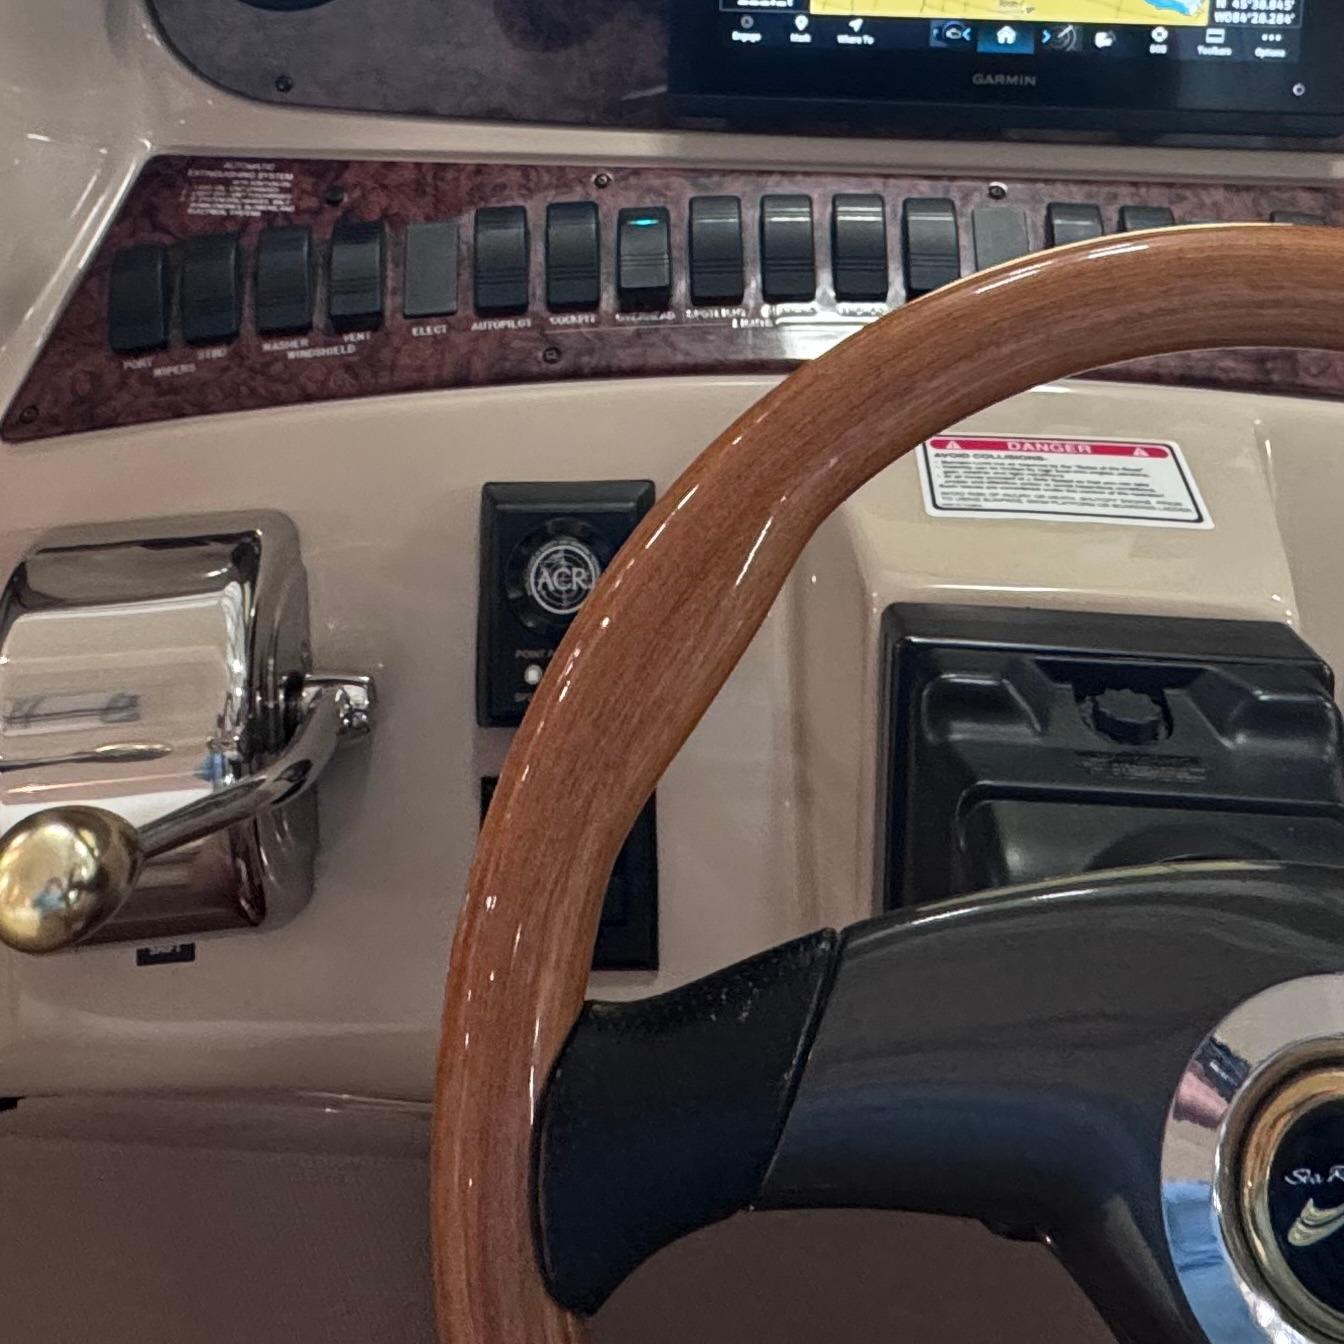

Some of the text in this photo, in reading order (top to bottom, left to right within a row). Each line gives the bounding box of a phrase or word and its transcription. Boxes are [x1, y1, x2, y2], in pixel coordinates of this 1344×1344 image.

[971, 72, 1037, 87] GARMIN
[470, 317, 532, 331] AUTOPILOT
[548, 313, 596, 326] COCKPIT
[343, 330, 372, 344] VENT
[411, 323, 448, 337] ELECT
[262, 337, 309, 352] WASHER
[286, 344, 356, 360] WINDSHIELD
[152, 363, 197, 378] WIPERS
[1006, 440, 1093, 454] DANGER
[537, 565, 587, 592] ACR
[1284, 1167, 1325, 1187] Sea
